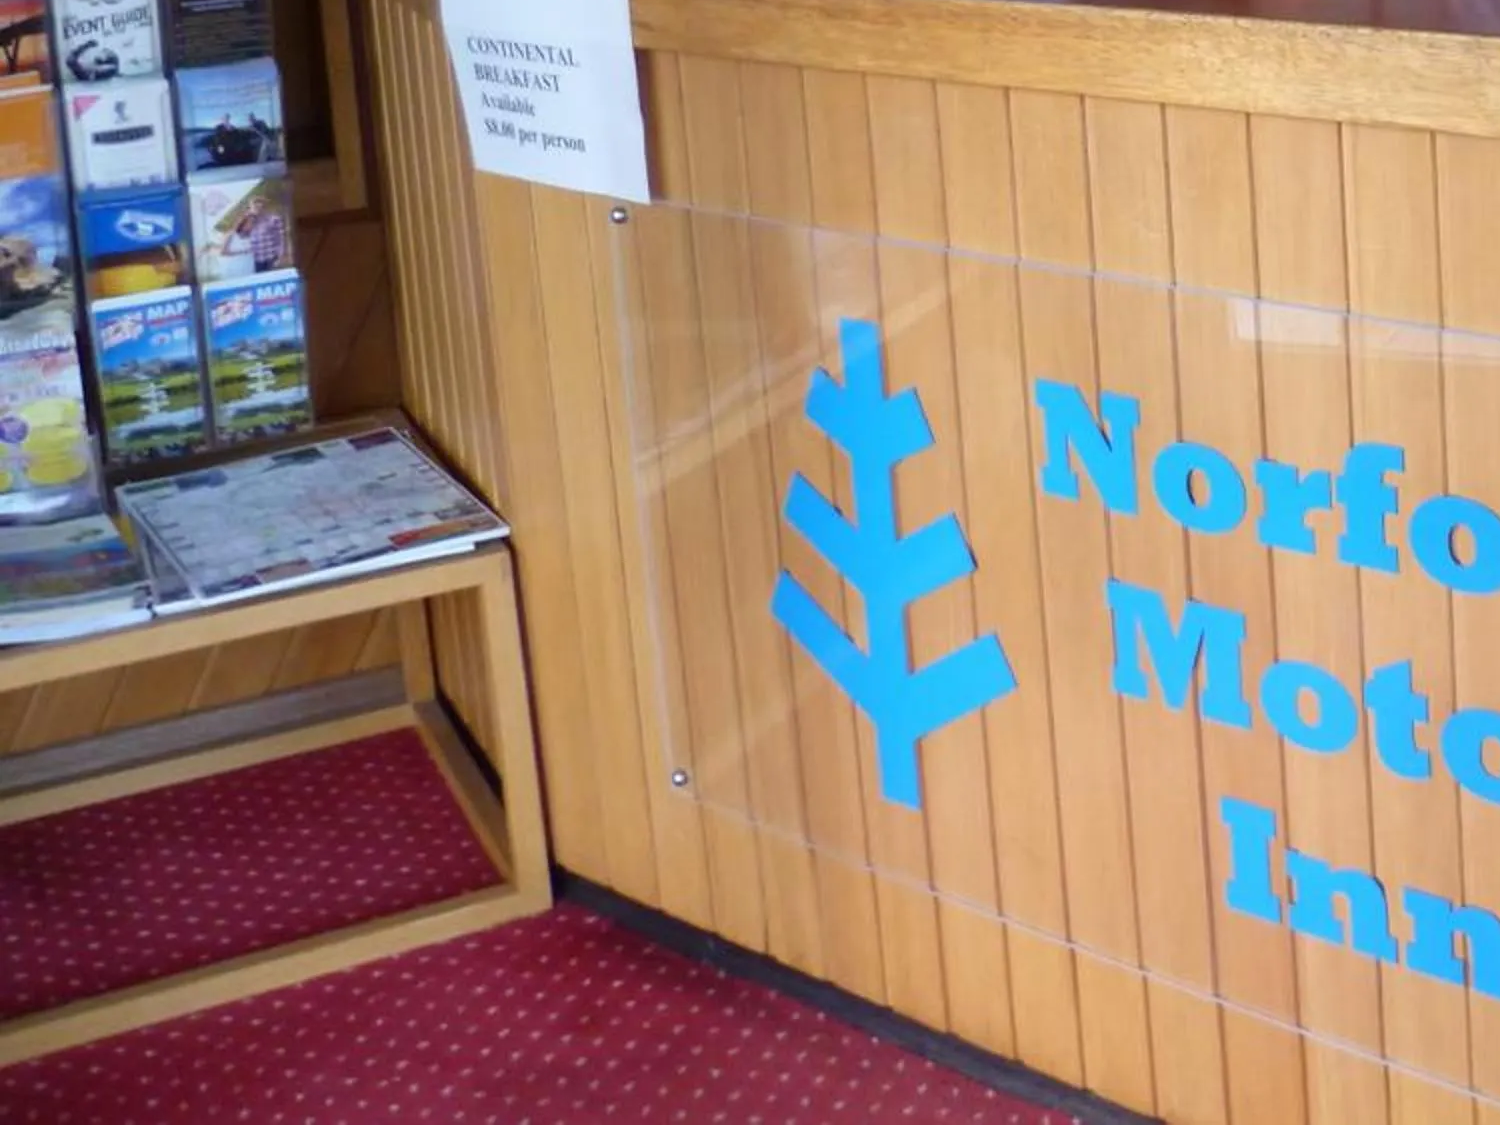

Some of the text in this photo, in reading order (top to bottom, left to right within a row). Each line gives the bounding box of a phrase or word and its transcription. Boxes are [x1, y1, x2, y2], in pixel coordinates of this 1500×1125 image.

[63, 15, 105, 41] EVENT
[467, 36, 579, 68] CONTINENTAL
[473, 63, 561, 93] BREAKFAST
[481, 92, 536, 117] Available
[518, 127, 538, 147] per
[542, 131, 587, 153] person
[256, 282, 297, 300] MAP
[146, 300, 189, 321] MAP
